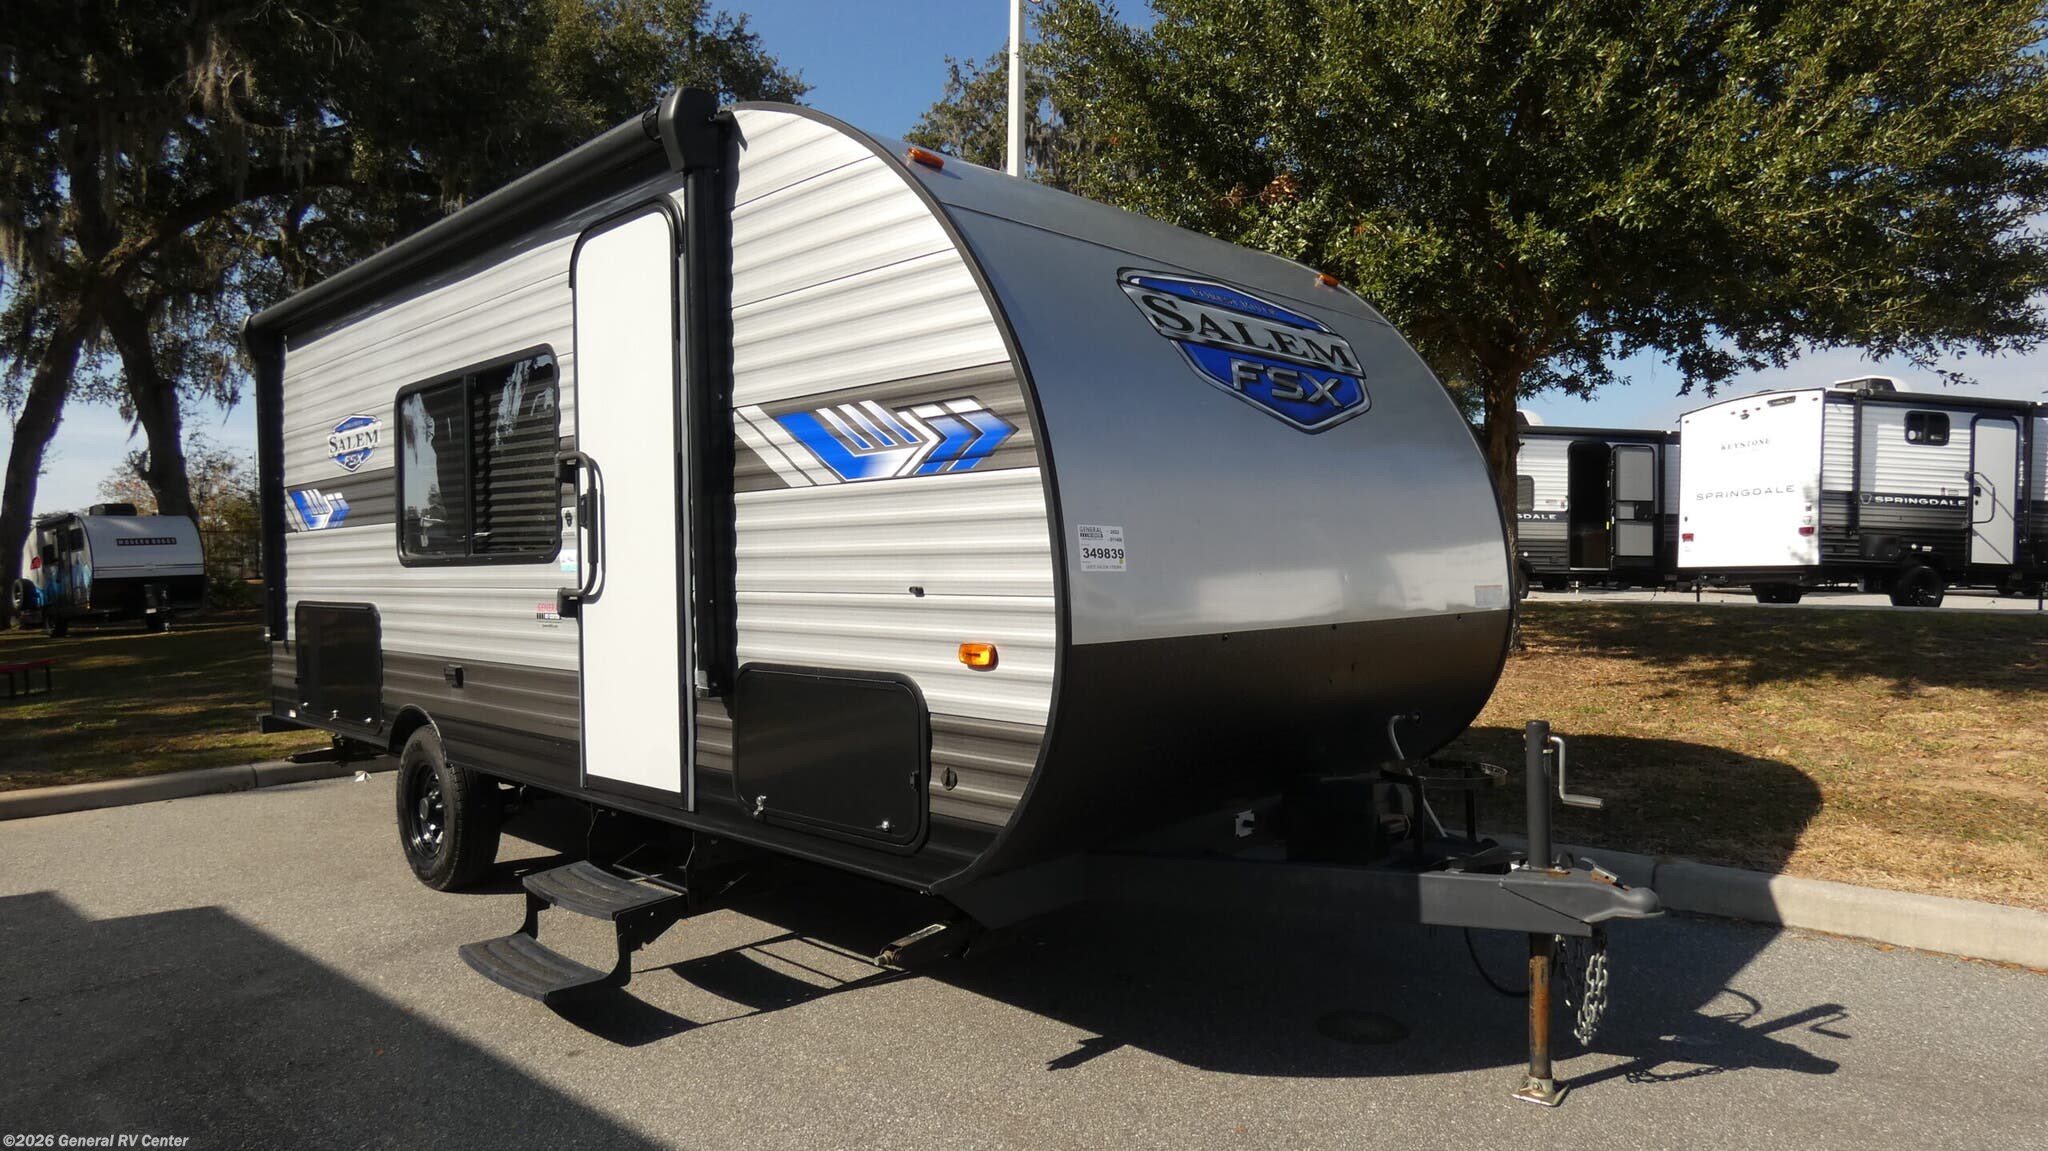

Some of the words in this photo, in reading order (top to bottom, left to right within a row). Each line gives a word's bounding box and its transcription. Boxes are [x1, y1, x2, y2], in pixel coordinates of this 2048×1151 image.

[1142, 294, 1358, 369] SALEM
[1230, 357, 1345, 409] FSX
[328, 429, 378, 454] SALEM
[1696, 484, 1796, 501] SPRINGDALE
[1874, 495, 1968, 507] SPRINGDALE
[1083, 547, 1124, 559] 349839
